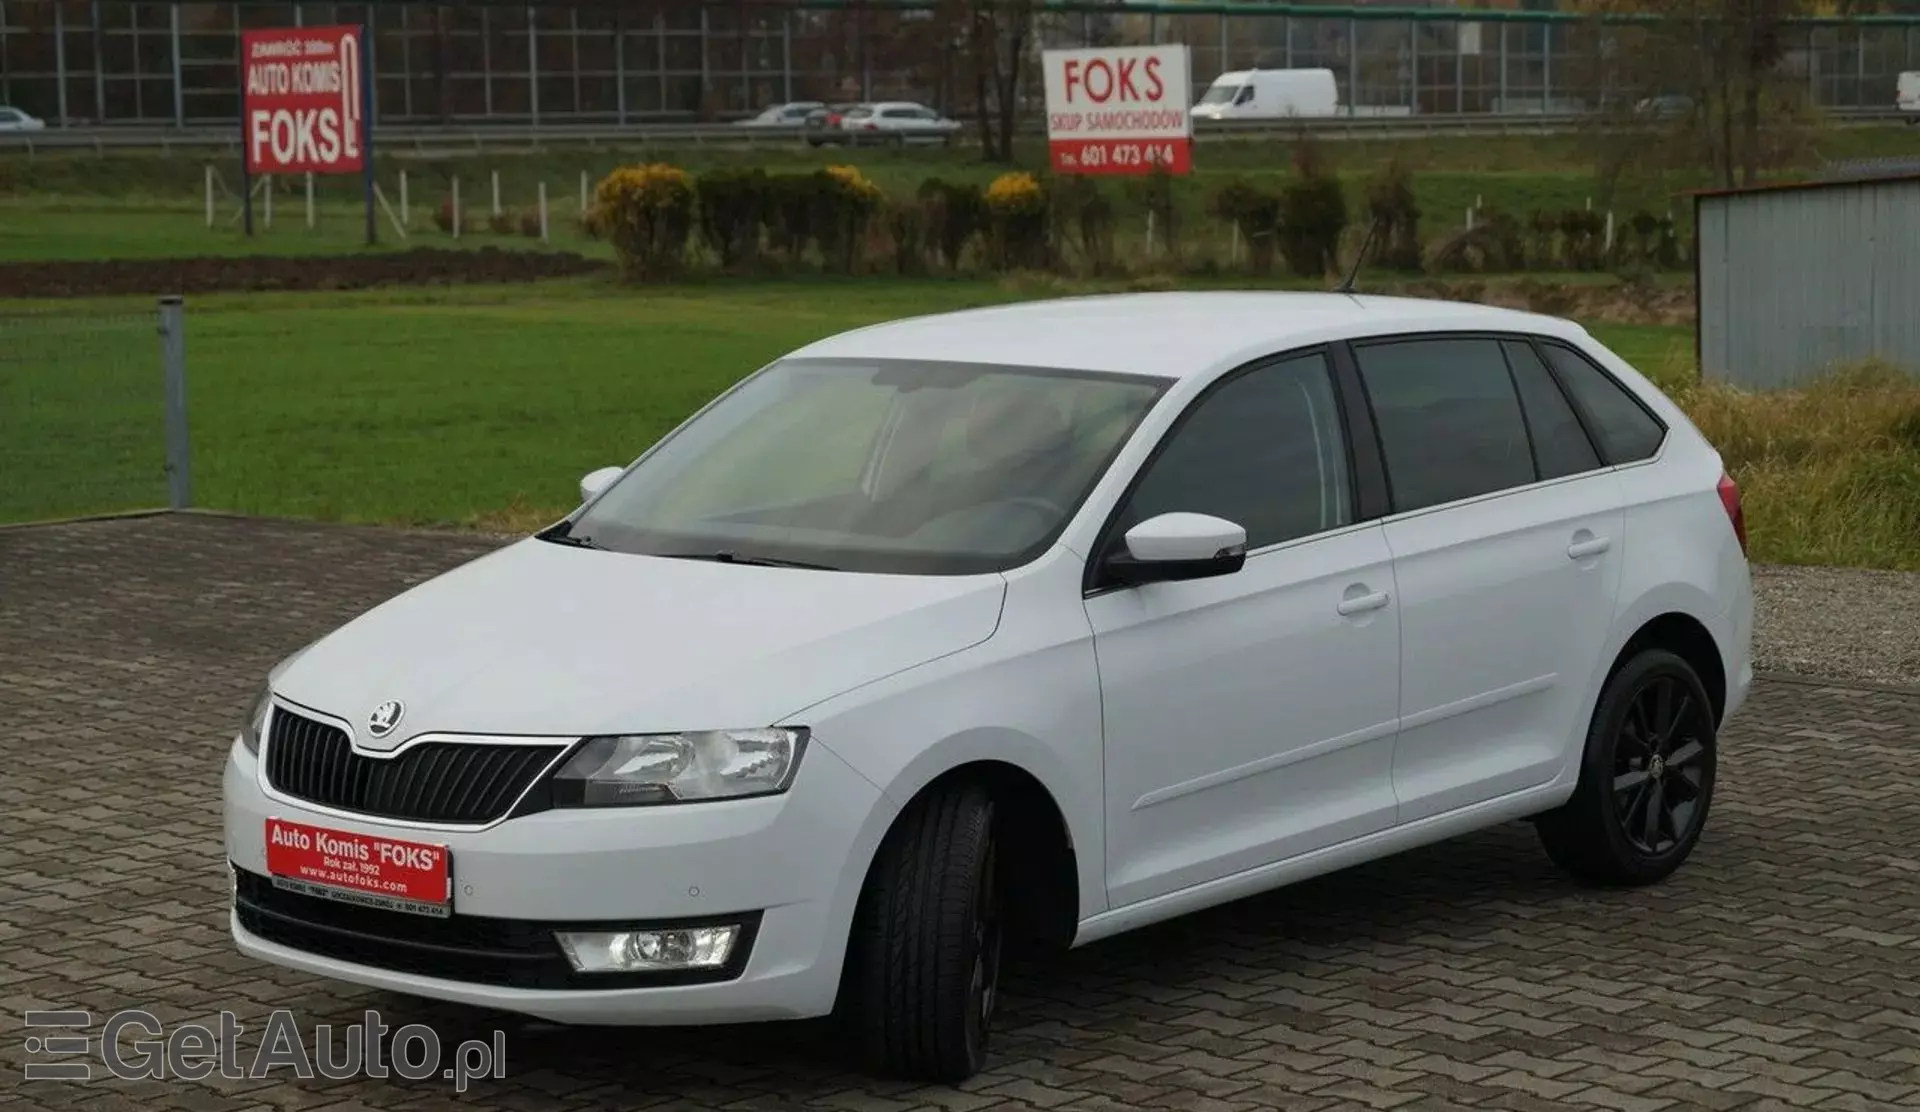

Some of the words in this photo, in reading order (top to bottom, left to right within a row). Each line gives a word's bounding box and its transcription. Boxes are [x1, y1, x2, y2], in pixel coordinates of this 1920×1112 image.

[248, 62, 289, 95] AUTO
[291, 60, 341, 93] KOMIS
[1064, 56, 1164, 104] FOKS
[1051, 112, 1082, 131] SKUP
[1085, 108, 1185, 131] SAMOCHODÓW
[251, 107, 340, 165] FOKS
[1081, 144, 1107, 166] 601
[1112, 143, 1141, 165] 473
[271, 824, 310, 850] Auto
[315, 831, 370, 861] Komis
[373, 841, 440, 871] "FOKS"
[299, 865, 408, 893] www.autofoks.com
[323, 856, 341, 869] Rok
[360, 862, 381, 876] 1992
